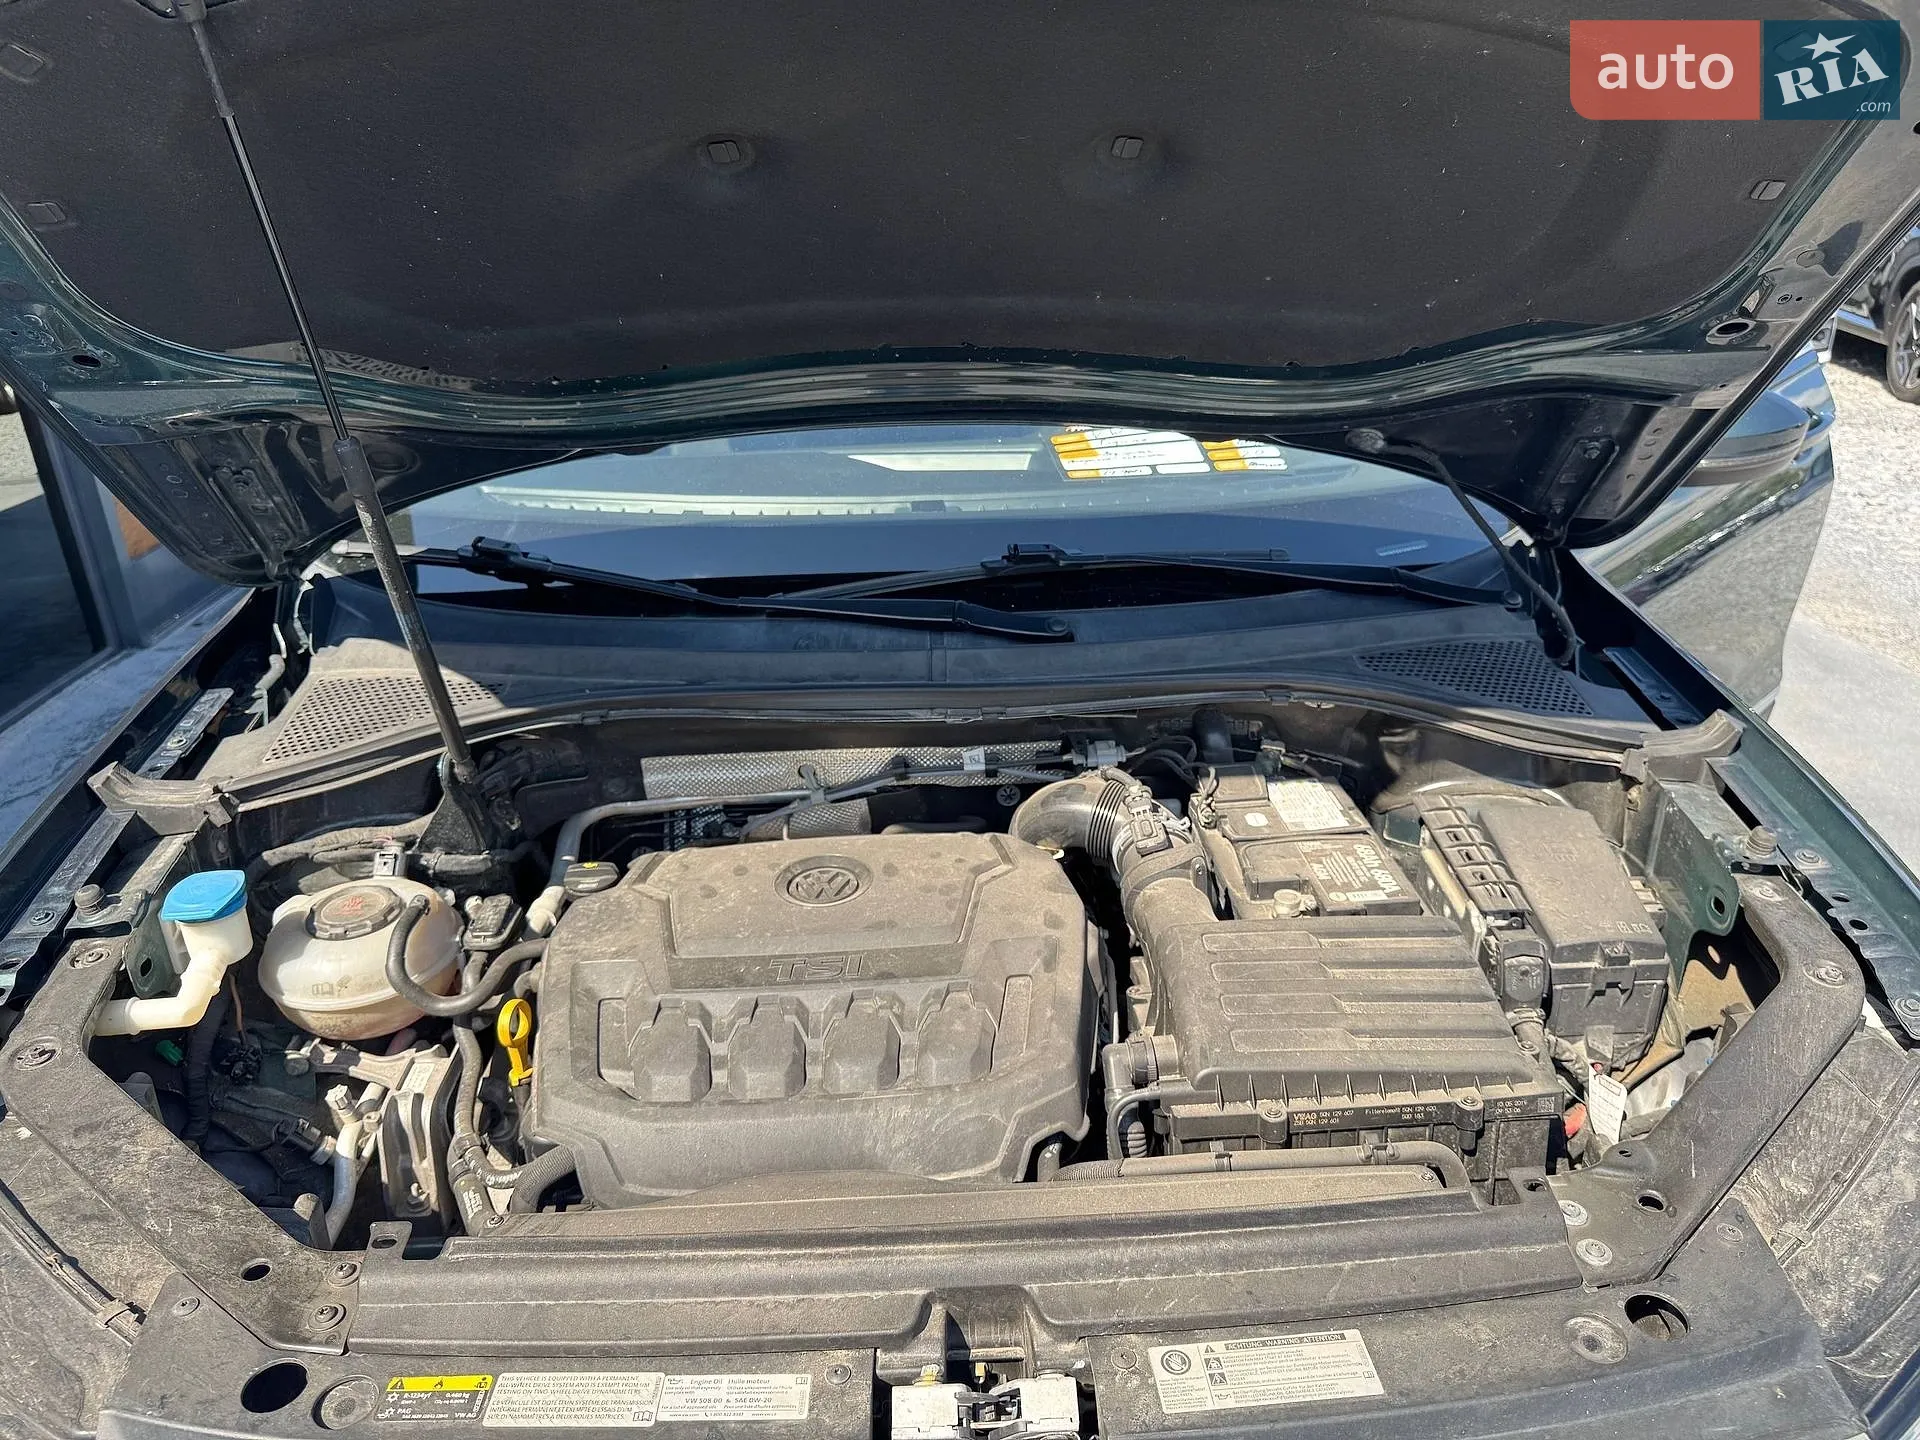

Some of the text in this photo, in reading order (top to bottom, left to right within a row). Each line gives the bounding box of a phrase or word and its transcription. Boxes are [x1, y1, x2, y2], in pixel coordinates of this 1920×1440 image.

[768, 954, 864, 983] TSI
[1228, 1334, 1341, 1350] ACHTUNG WARNING ATTENTION
